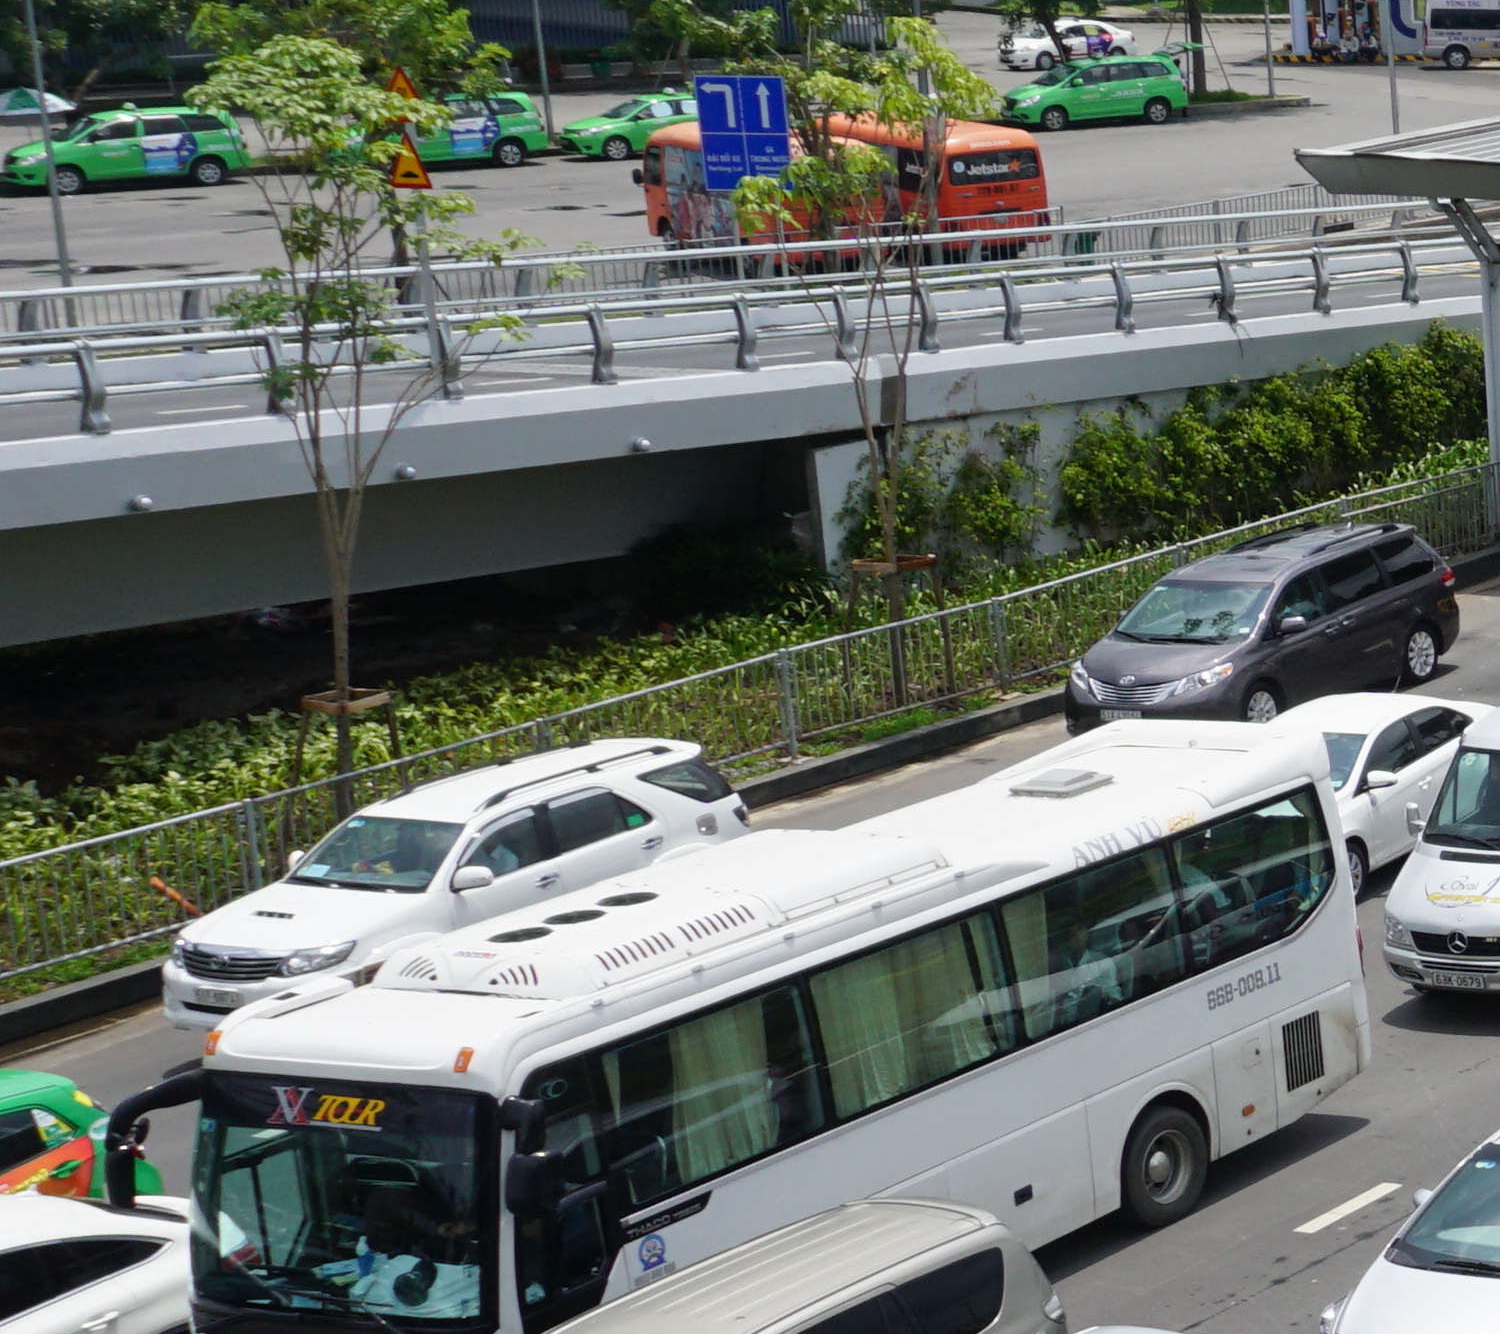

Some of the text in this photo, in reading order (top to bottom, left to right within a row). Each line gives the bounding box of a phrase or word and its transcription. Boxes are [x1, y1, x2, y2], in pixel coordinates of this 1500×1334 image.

[966, 163, 1009, 176] Jetstar
[1072, 833, 1124, 871] ANH
[312, 1094, 386, 1126] TOUR
